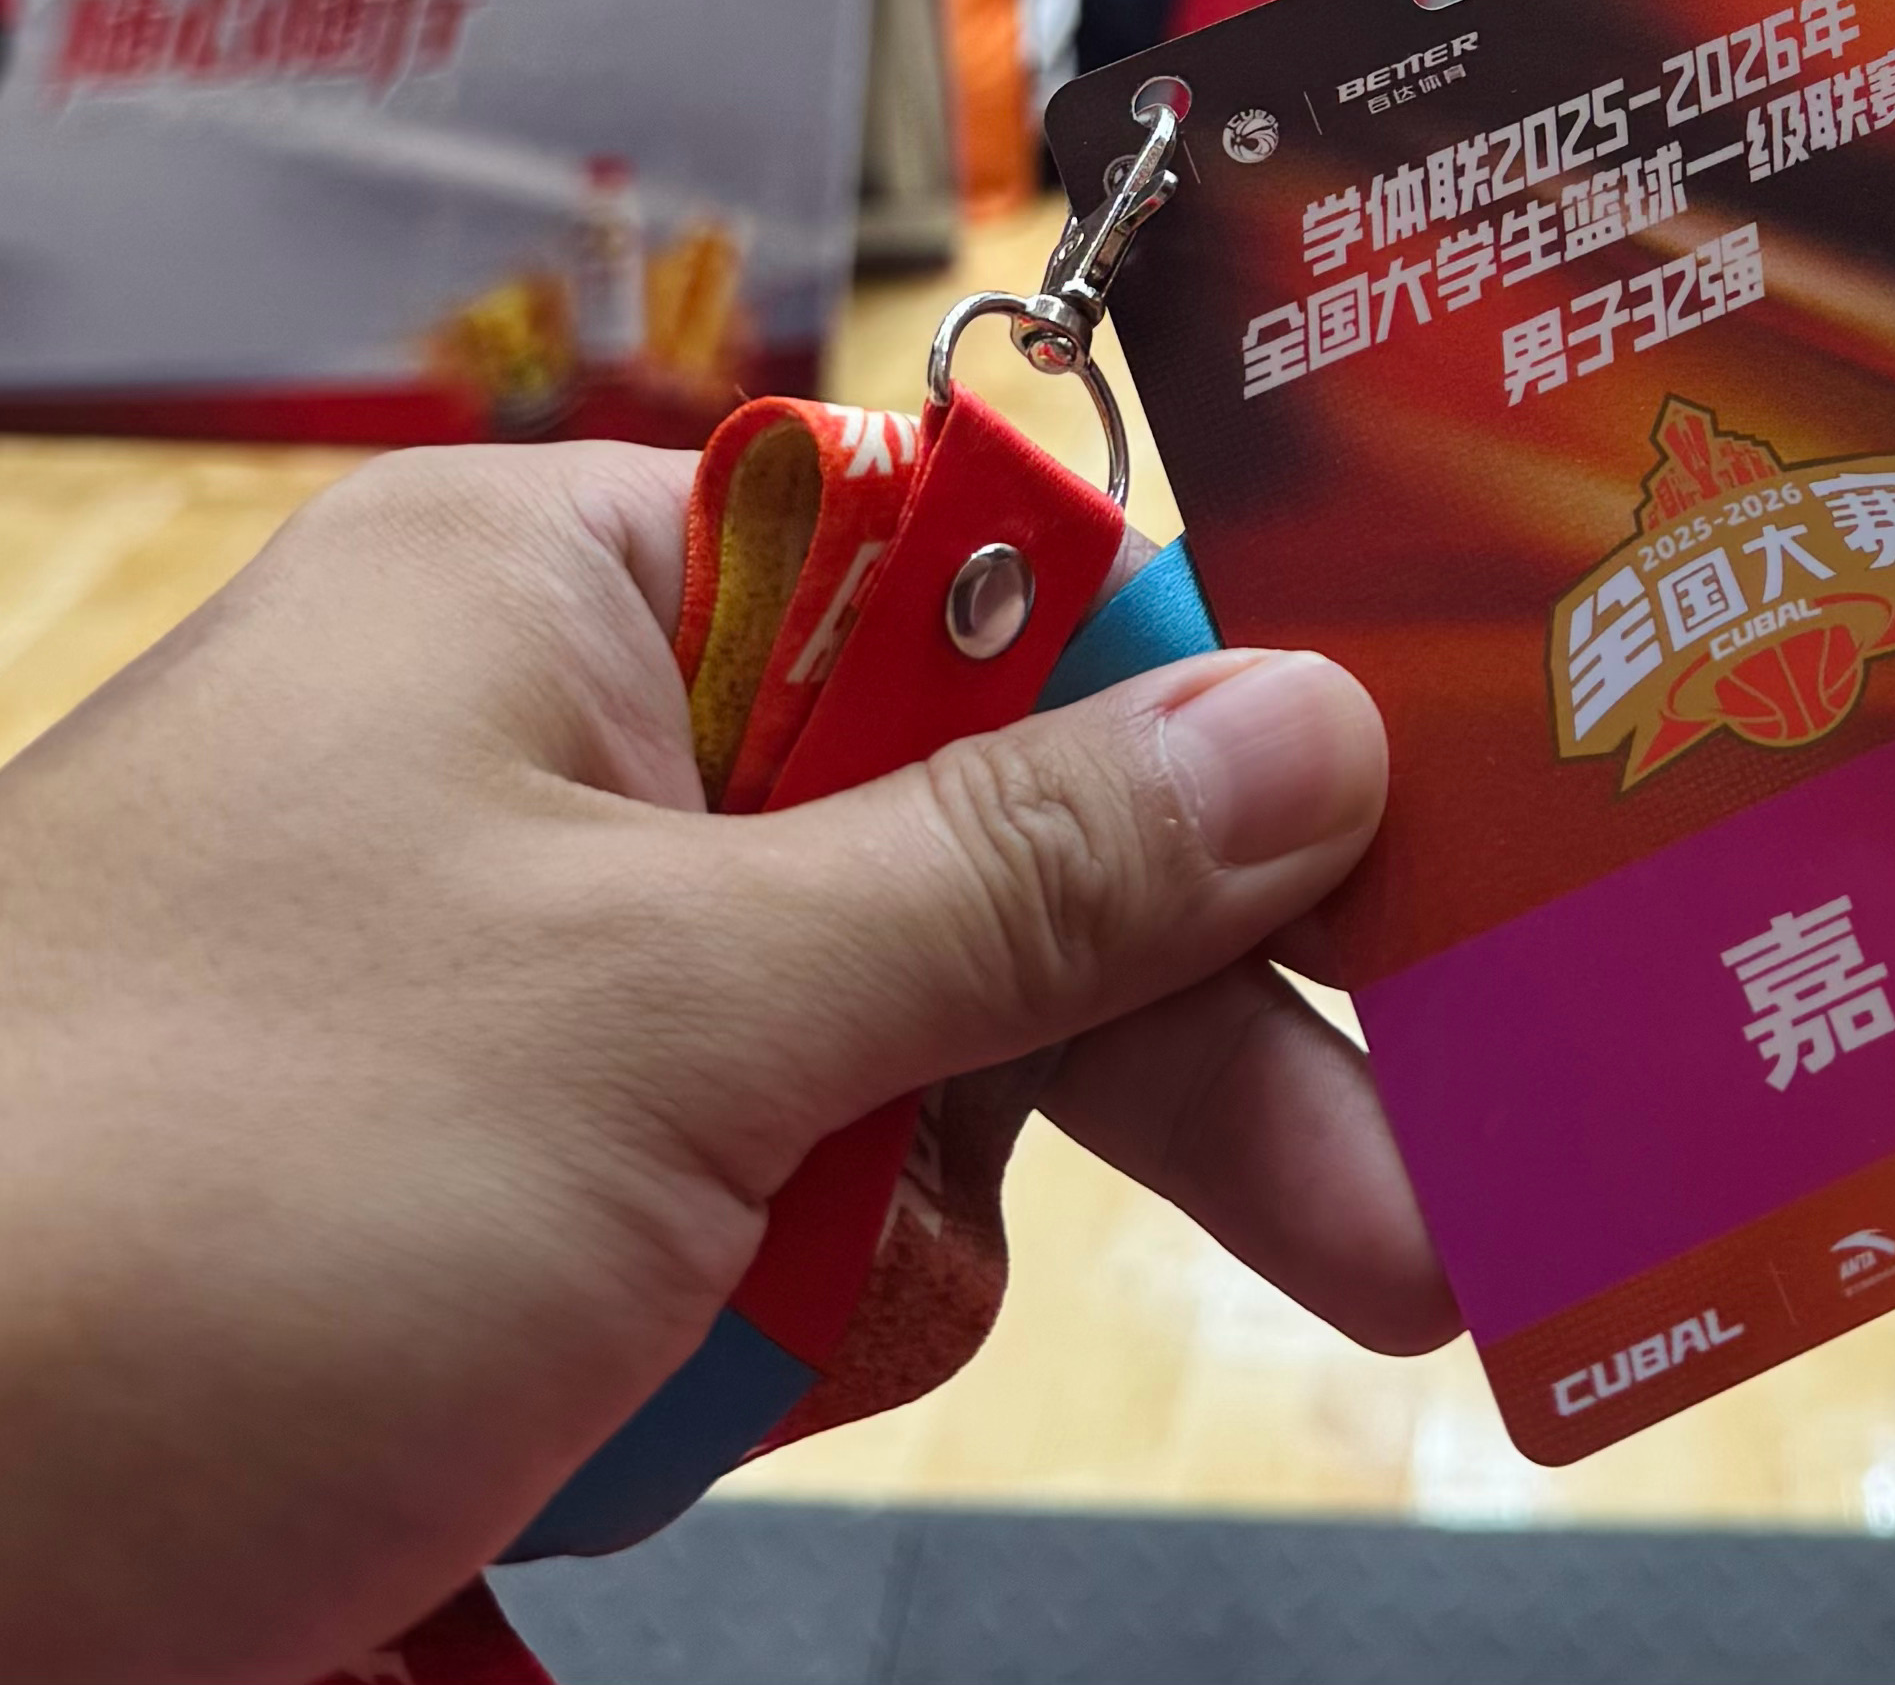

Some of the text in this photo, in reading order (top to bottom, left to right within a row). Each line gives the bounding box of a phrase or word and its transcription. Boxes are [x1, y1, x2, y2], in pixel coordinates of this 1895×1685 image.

[1337, 31, 1479, 104] BETTER
[1367, 63, 1467, 115] 百达体育
[1502, 224, 1766, 407] 男子32强
[1637, 481, 1803, 573] 2025-2026
[1710, 598, 1823, 661] CUBAL
[1552, 1308, 1744, 1416] CUBAL
